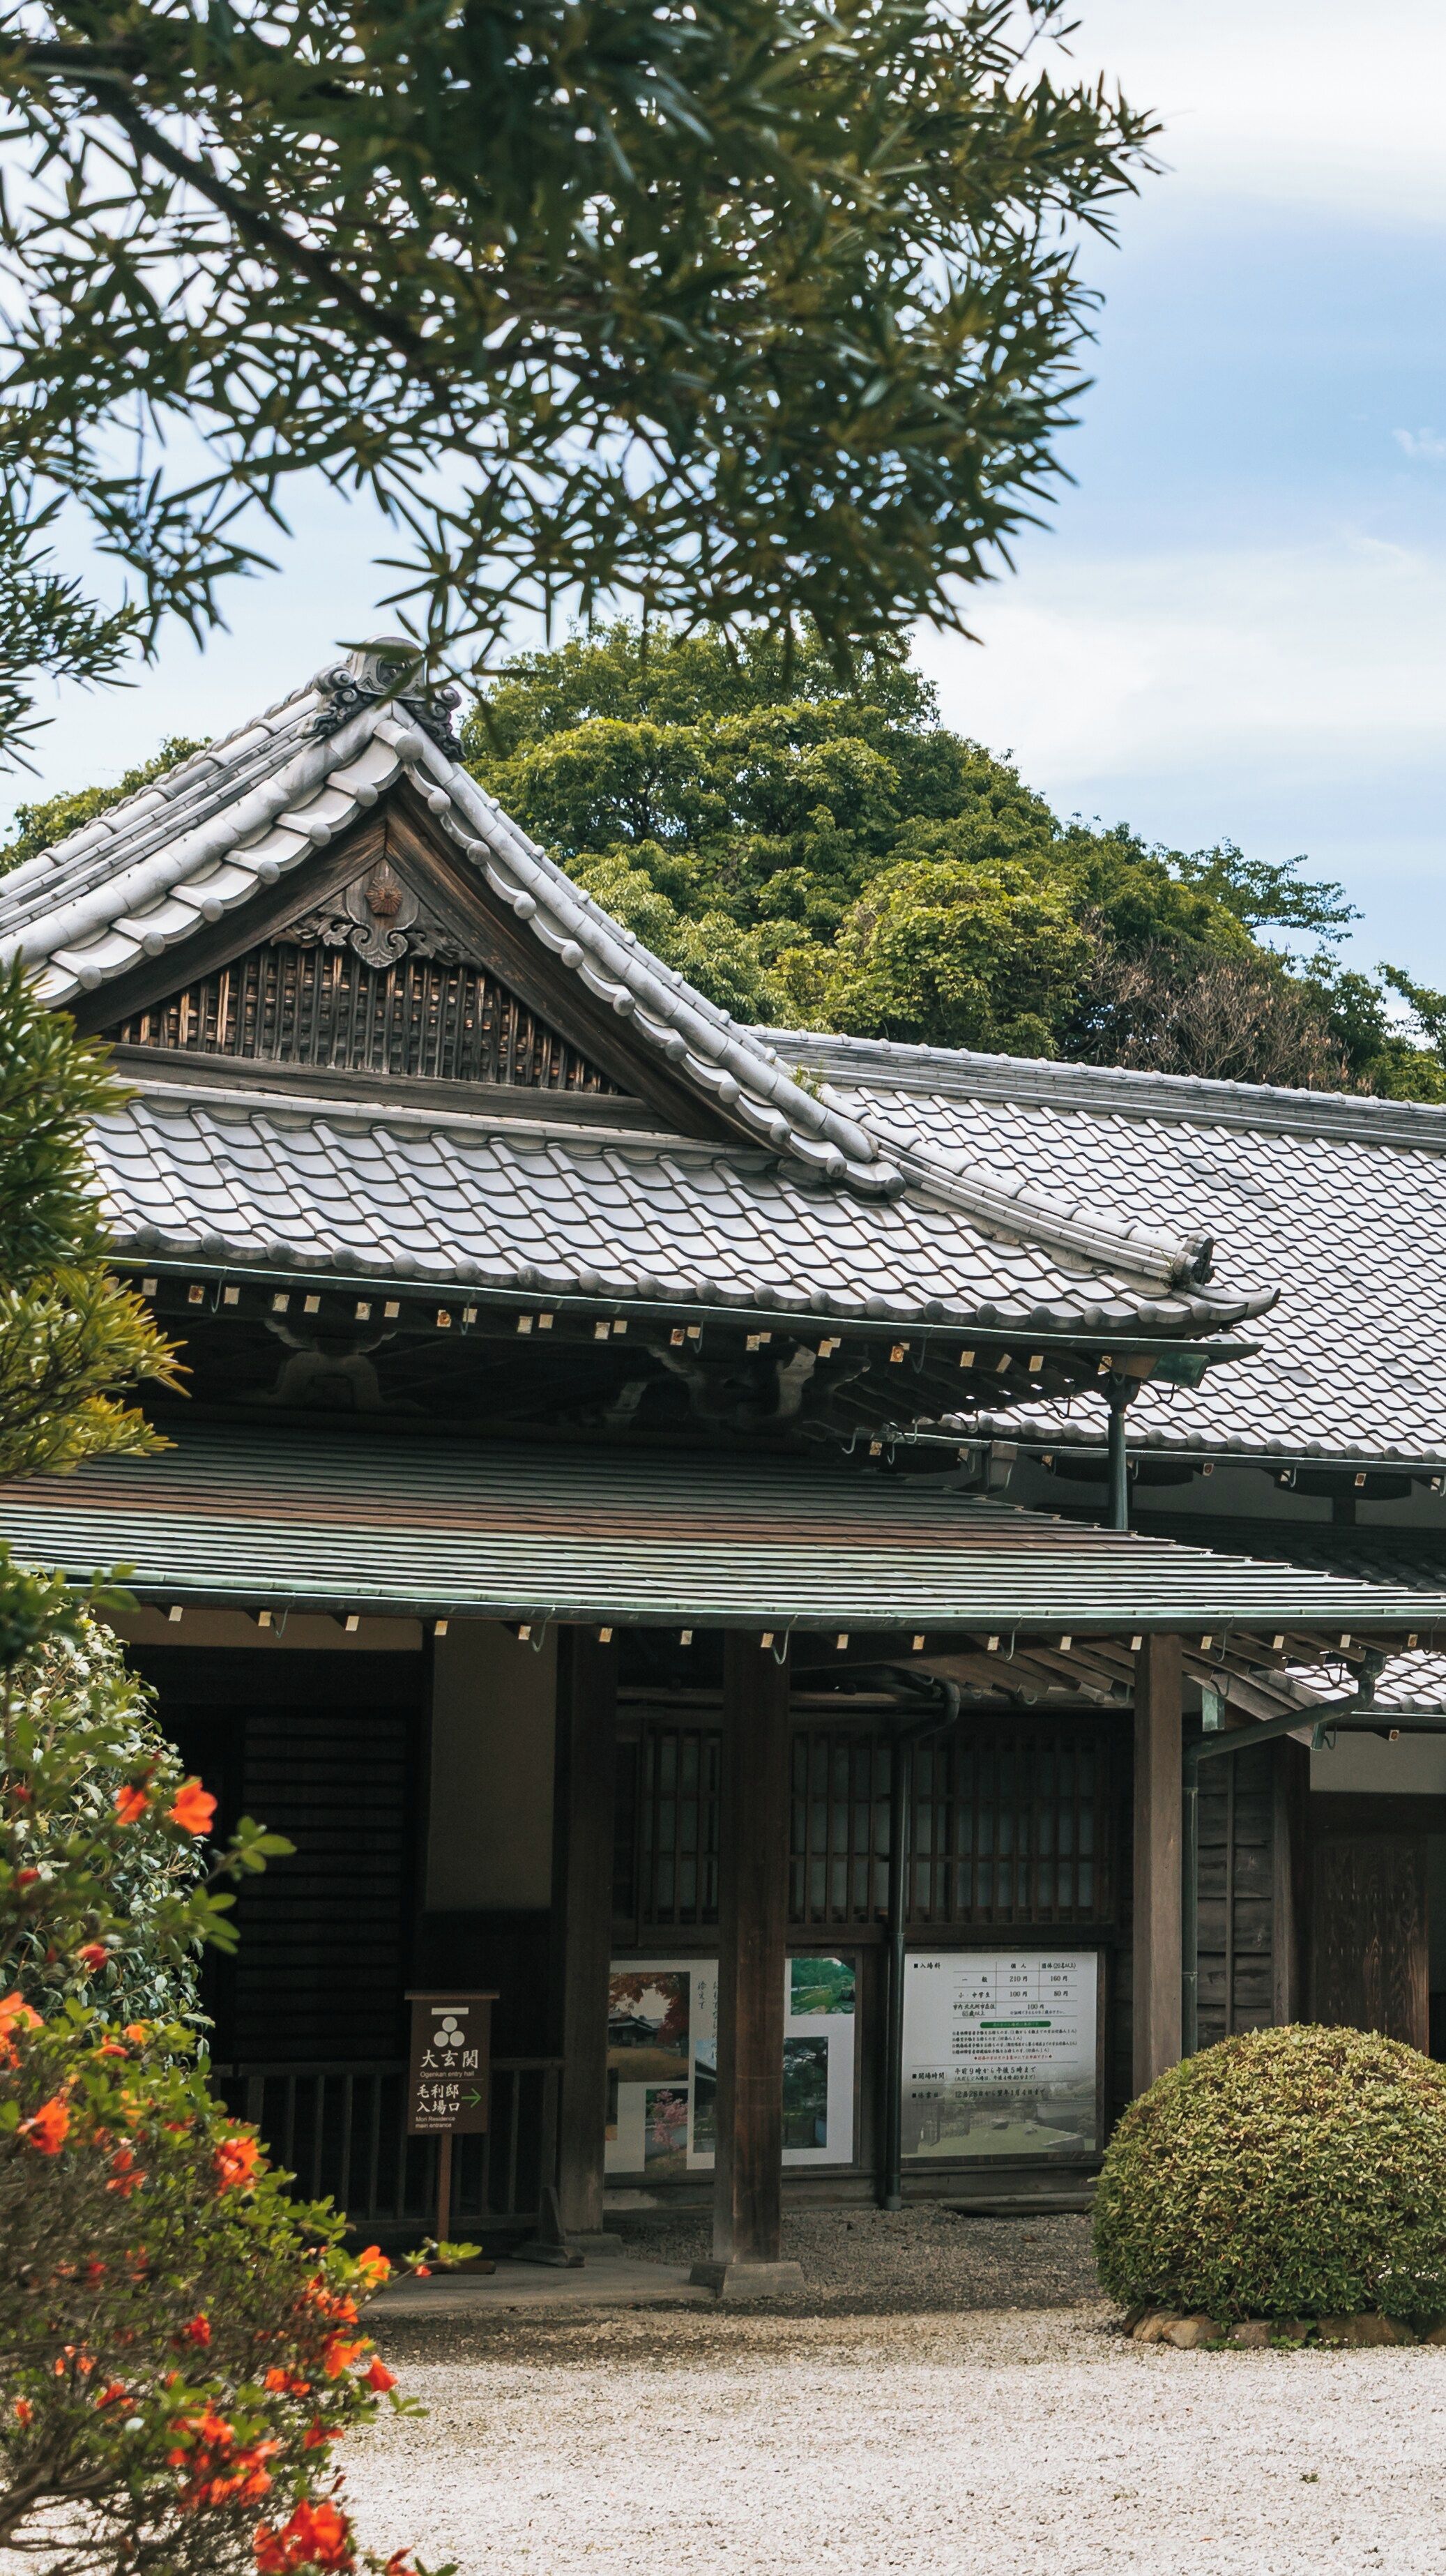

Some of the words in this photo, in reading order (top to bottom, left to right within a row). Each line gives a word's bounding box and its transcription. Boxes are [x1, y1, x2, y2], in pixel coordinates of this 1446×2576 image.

[420, 2049, 478, 2069] 大玄関
[417, 2083, 459, 2099] 毛利邸
[416, 2100, 460, 2115] 入場口
